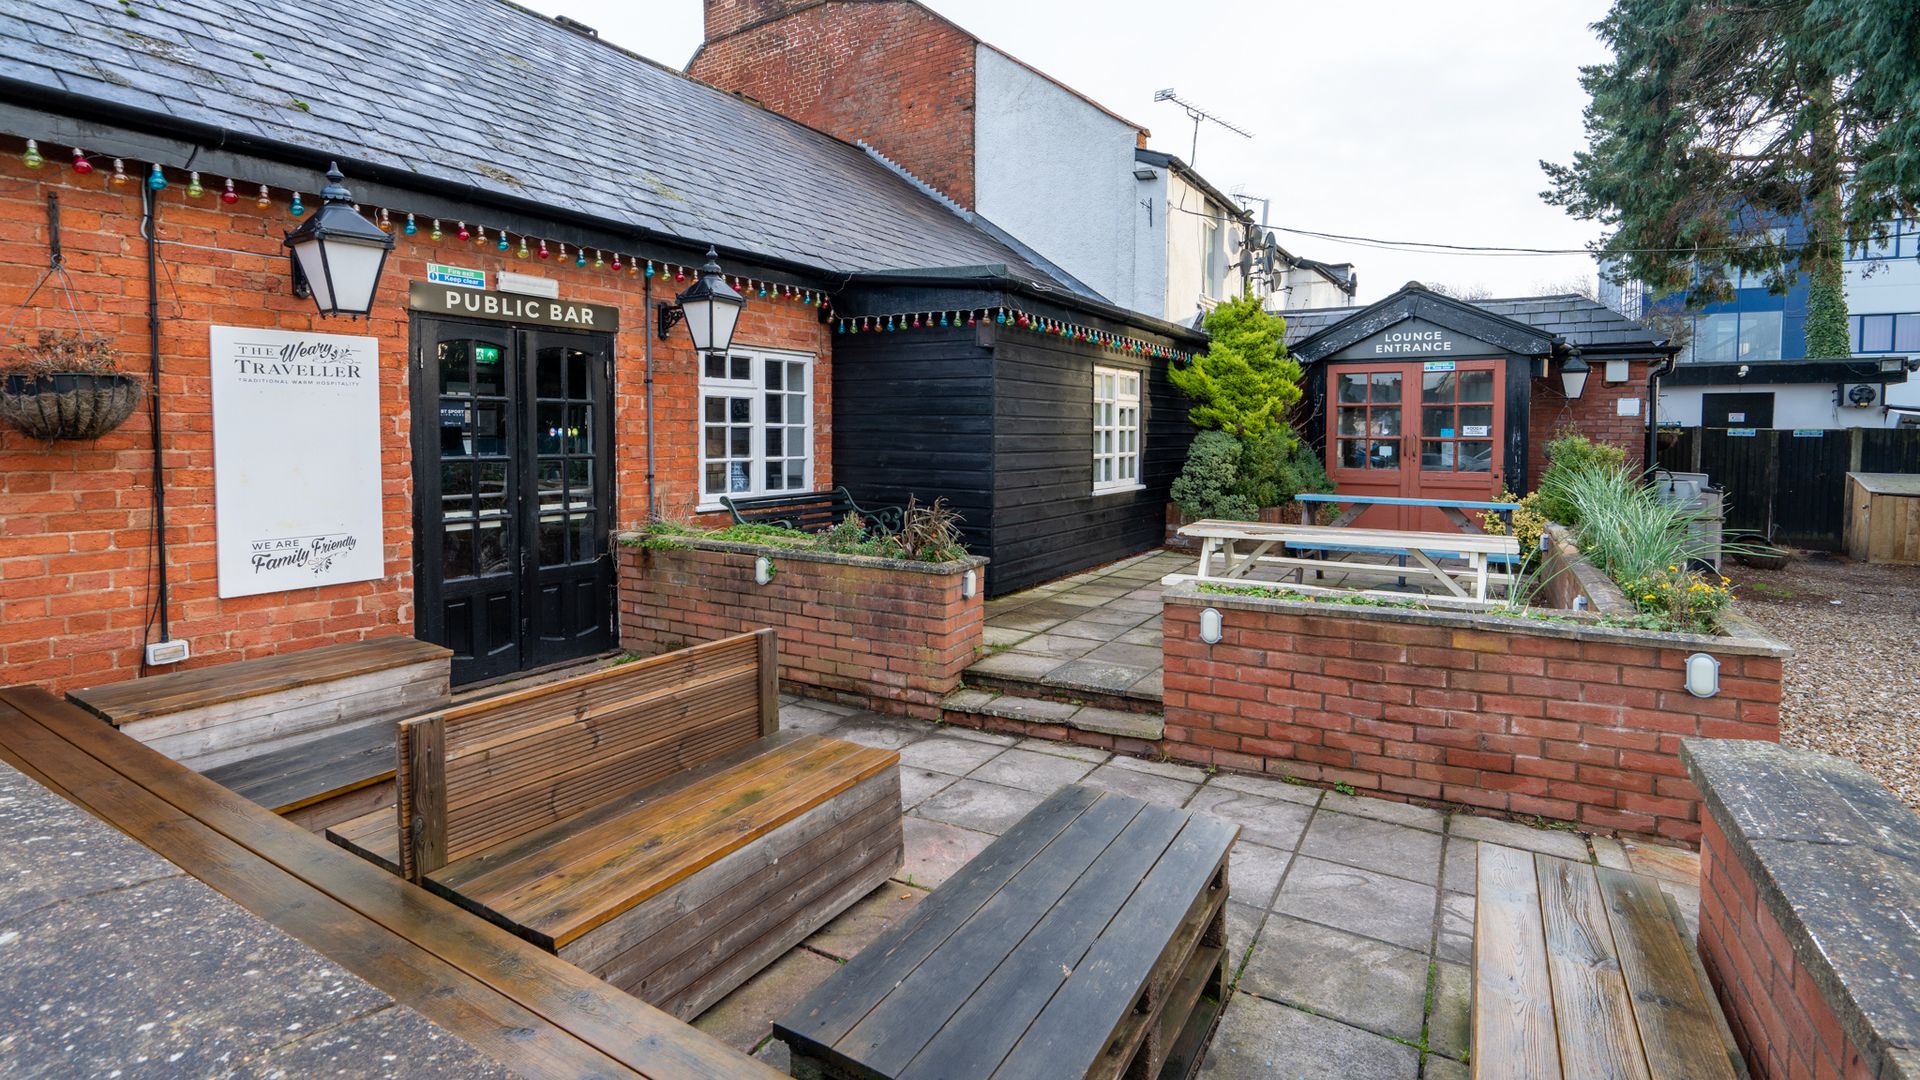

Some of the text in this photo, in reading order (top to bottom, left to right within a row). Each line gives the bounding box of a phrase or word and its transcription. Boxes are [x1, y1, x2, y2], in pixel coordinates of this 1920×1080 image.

[444, 274, 479, 285] Keep clear
[446, 291, 594, 325] PUBLIC BAR
[1385, 331, 1442, 343] LOUNGE
[238, 341, 333, 362] THE Weary
[1375, 342, 1452, 354] ENTRANCE
[234, 359, 361, 378] TRAVELLER
[238, 377, 289, 385] TRADITIONAL
[252, 540, 300, 551] WE ARE
[251, 535, 357, 574] Family Friendly
